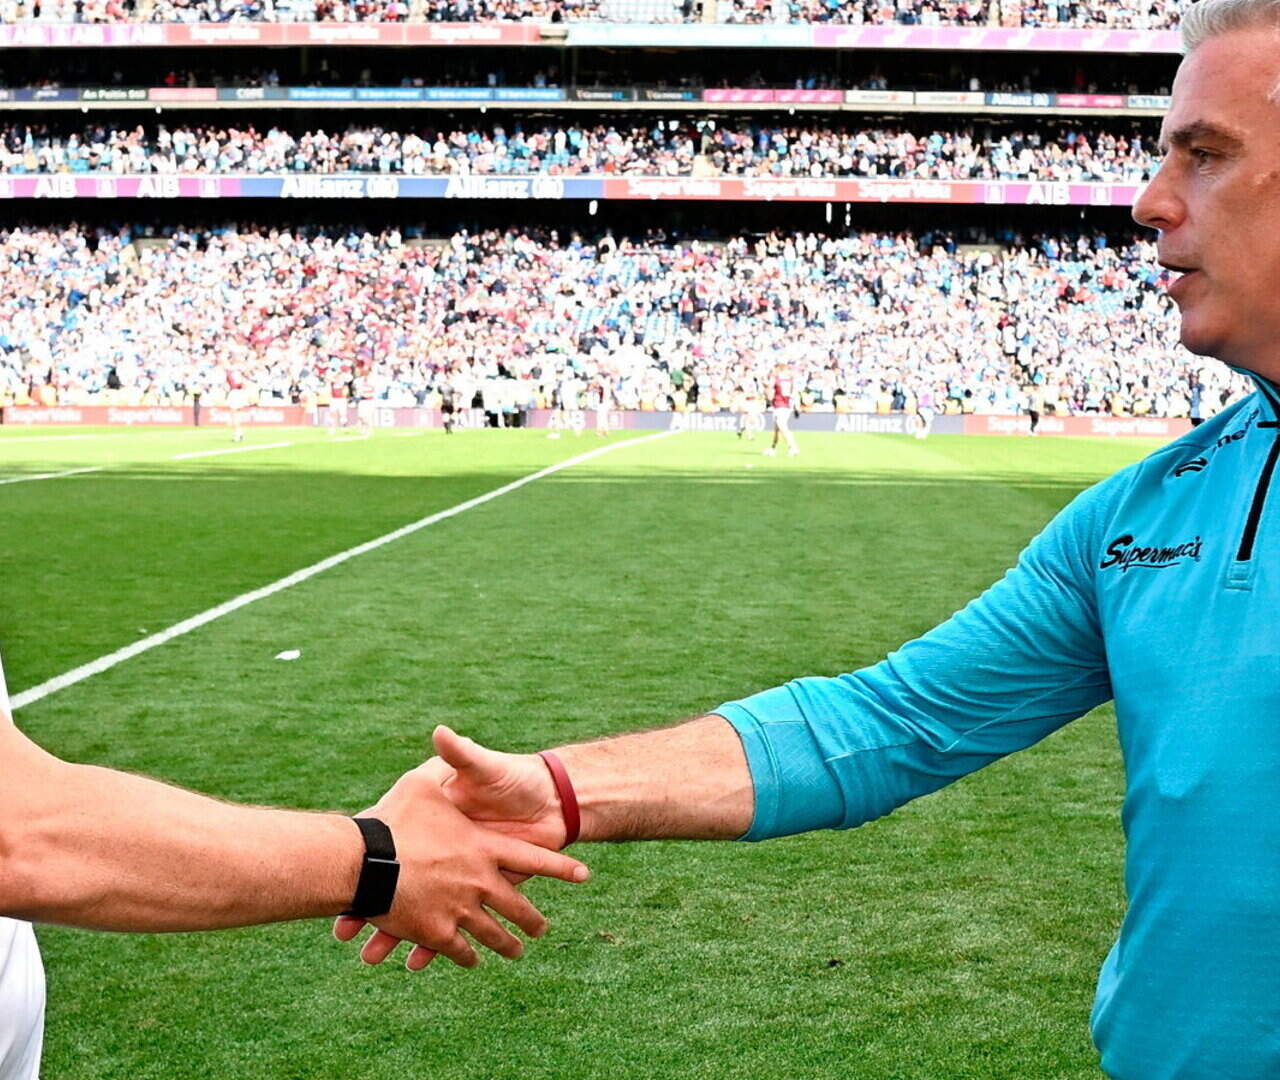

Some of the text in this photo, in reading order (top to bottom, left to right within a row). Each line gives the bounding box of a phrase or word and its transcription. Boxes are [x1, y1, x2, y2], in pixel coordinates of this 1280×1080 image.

[34, 178, 76, 198] AIB
[136, 178, 180, 198] AIB
[280, 176, 363, 198] Allianz
[444, 176, 528, 198] Allianz
[628, 178, 720, 199] SuperValu
[743, 179, 836, 200] SuperValu
[858, 180, 951, 201] SuperValu
[1025, 182, 1070, 204] AIB
[7, 408, 81, 425] SuperValu
[108, 408, 182, 425] SuperValu
[670, 411, 737, 431] Allianz
[835, 414, 902, 434] Allianz
[1092, 418, 1168, 436] SuperValu
[1100, 534, 1204, 573] Supermac's
